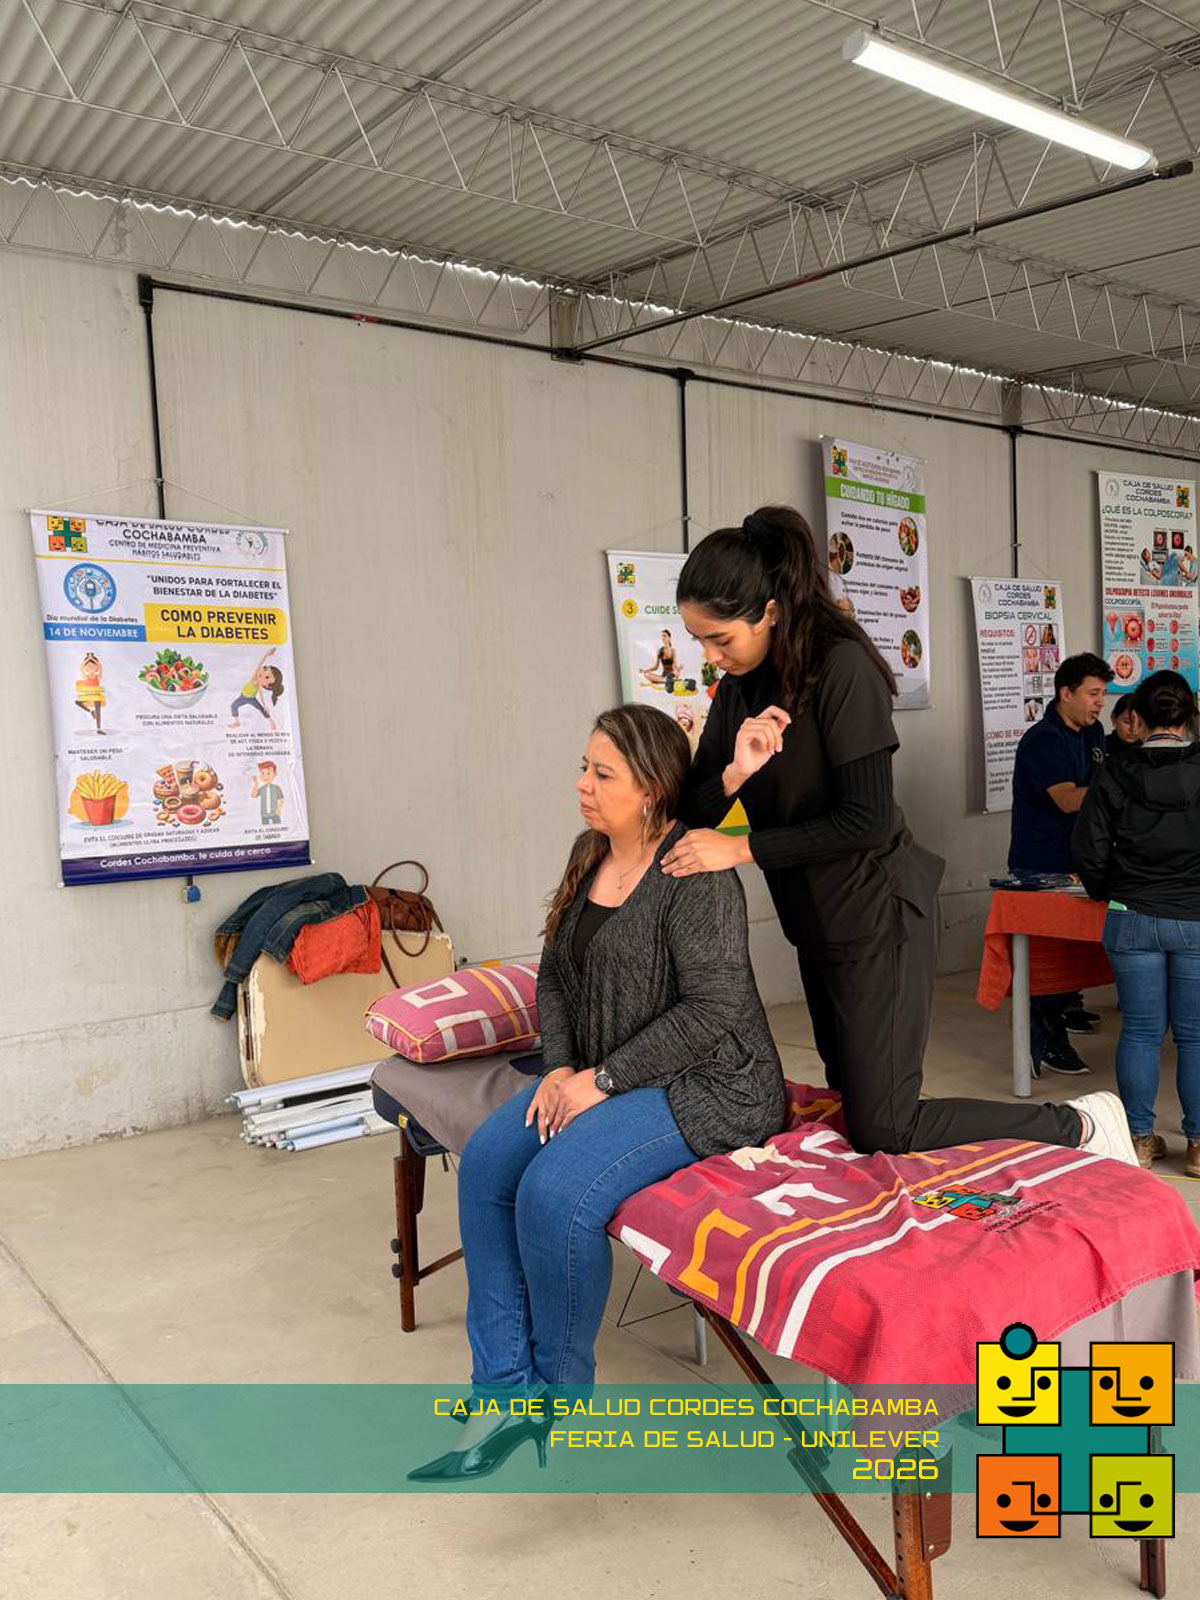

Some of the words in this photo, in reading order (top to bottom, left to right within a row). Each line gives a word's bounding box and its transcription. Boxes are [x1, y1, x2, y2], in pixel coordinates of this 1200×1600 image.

[1152, 483, 1174, 491] SALUD
[840, 483, 875, 504] CUIDANDO
[876, 490, 885, 506] TU
[1122, 507, 1131, 515] ES
[1133, 507, 1142, 516] LA
[123, 529, 207, 544] COCHABAMBA
[109, 539, 136, 549] CENTRO
[138, 541, 146, 549] DE
[148, 542, 182, 551] MEDICINA
[183, 544, 221, 554] PREVENTIVA
[161, 550, 201, 562] SALUDABLES
[188, 576, 214, 587] PARA
[216, 578, 270, 589] FORTALECER
[272, 580, 282, 590] EL
[993, 583, 1011, 592] CAJA
[1012, 584, 1021, 592] DE
[1021, 585, 1042, 593] SALUD
[153, 586, 203, 597] BIENESTAR
[205, 589, 217, 598] DE
[219, 590, 231, 598] LA
[644, 605, 671, 615] CUIDE
[984, 611, 1015, 620] BIOPSIA
[1017, 611, 1052, 621] CERVICAL
[160, 609, 202, 623] COMO
[206, 610, 277, 626] PREVENIR
[49, 628, 60, 637] 14
[63, 628, 78, 637] DE
[80, 628, 139, 638] NOVIEMBRE
[177, 625, 196, 638] LA
[201, 626, 269, 640] DIABETES
[100, 859, 132, 868] Cordes
[199, 851, 207, 860] le
[209, 848, 233, 859] cuida
[235, 847, 245, 857] de
[247, 846, 272, 857] cerca
